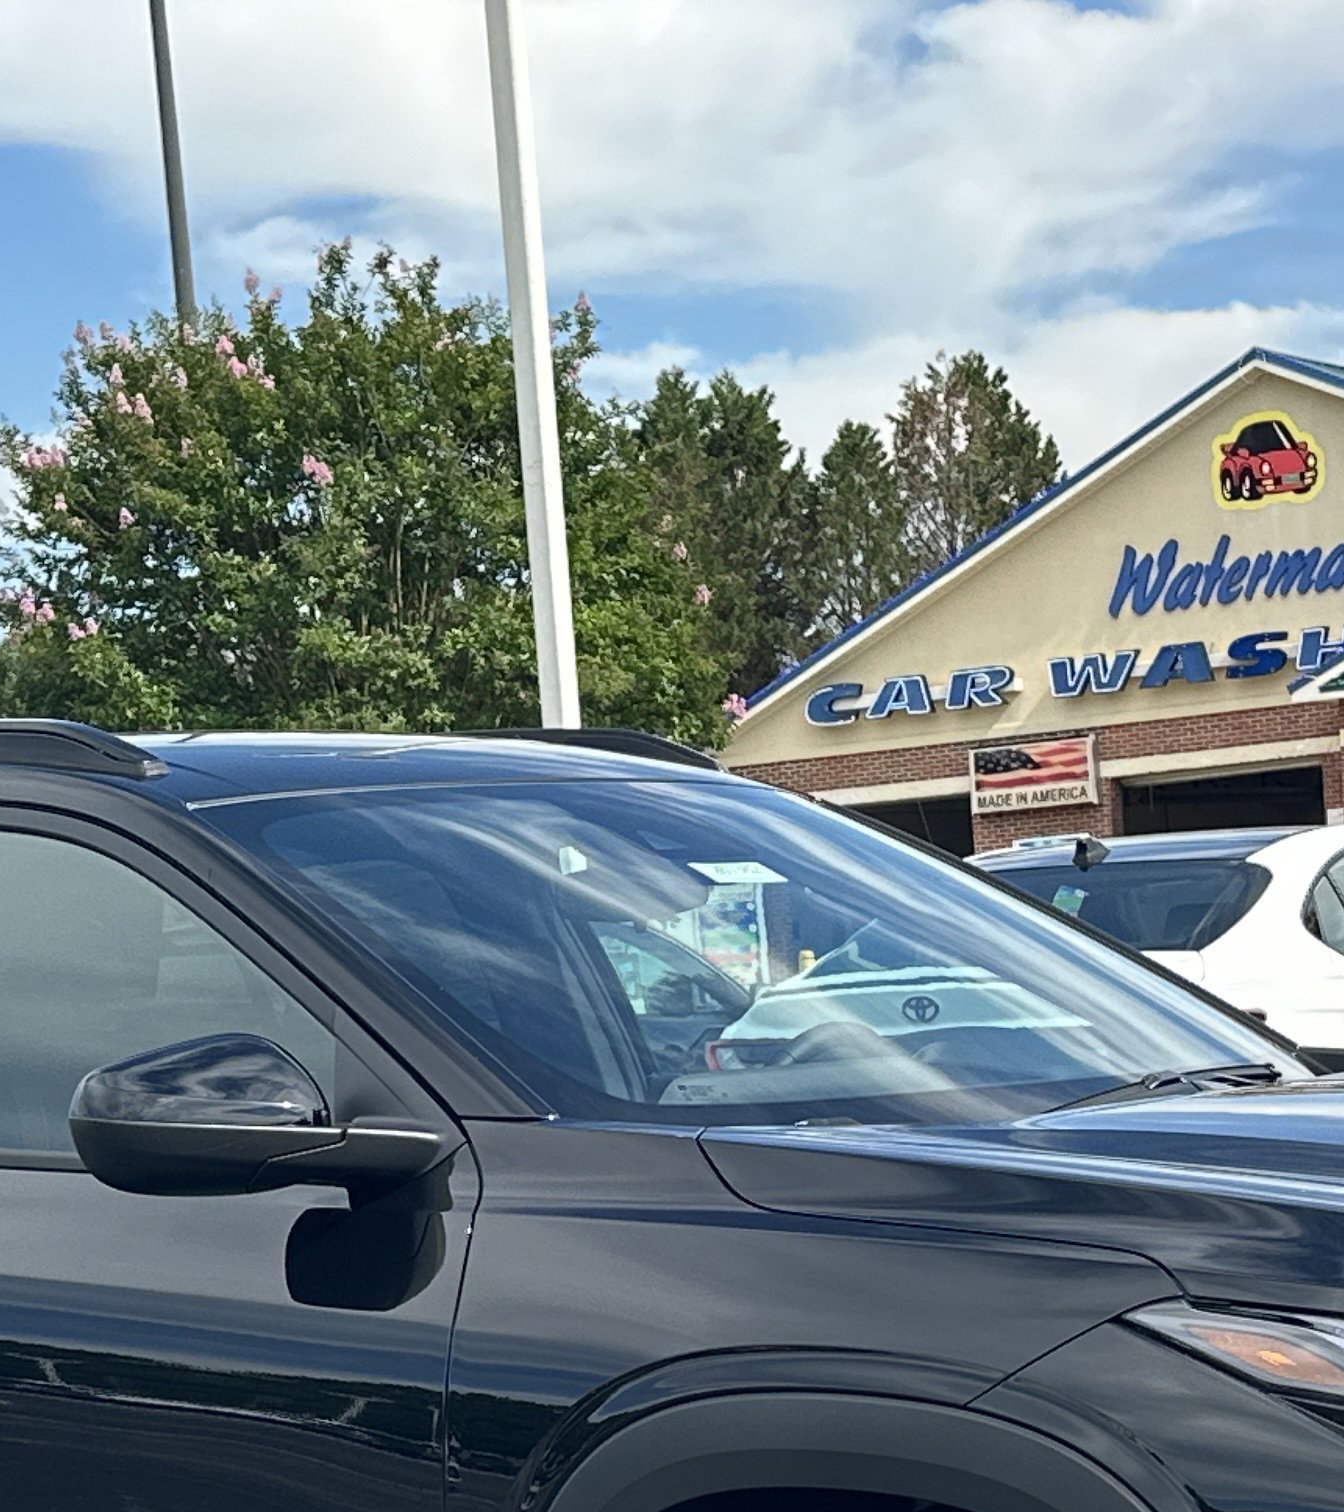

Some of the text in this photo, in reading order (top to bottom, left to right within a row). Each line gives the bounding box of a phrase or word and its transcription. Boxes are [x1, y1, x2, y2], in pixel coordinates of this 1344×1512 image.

[804, 665, 1015, 727] CAR
[977, 785, 1089, 808] MADE IN AMERICA
